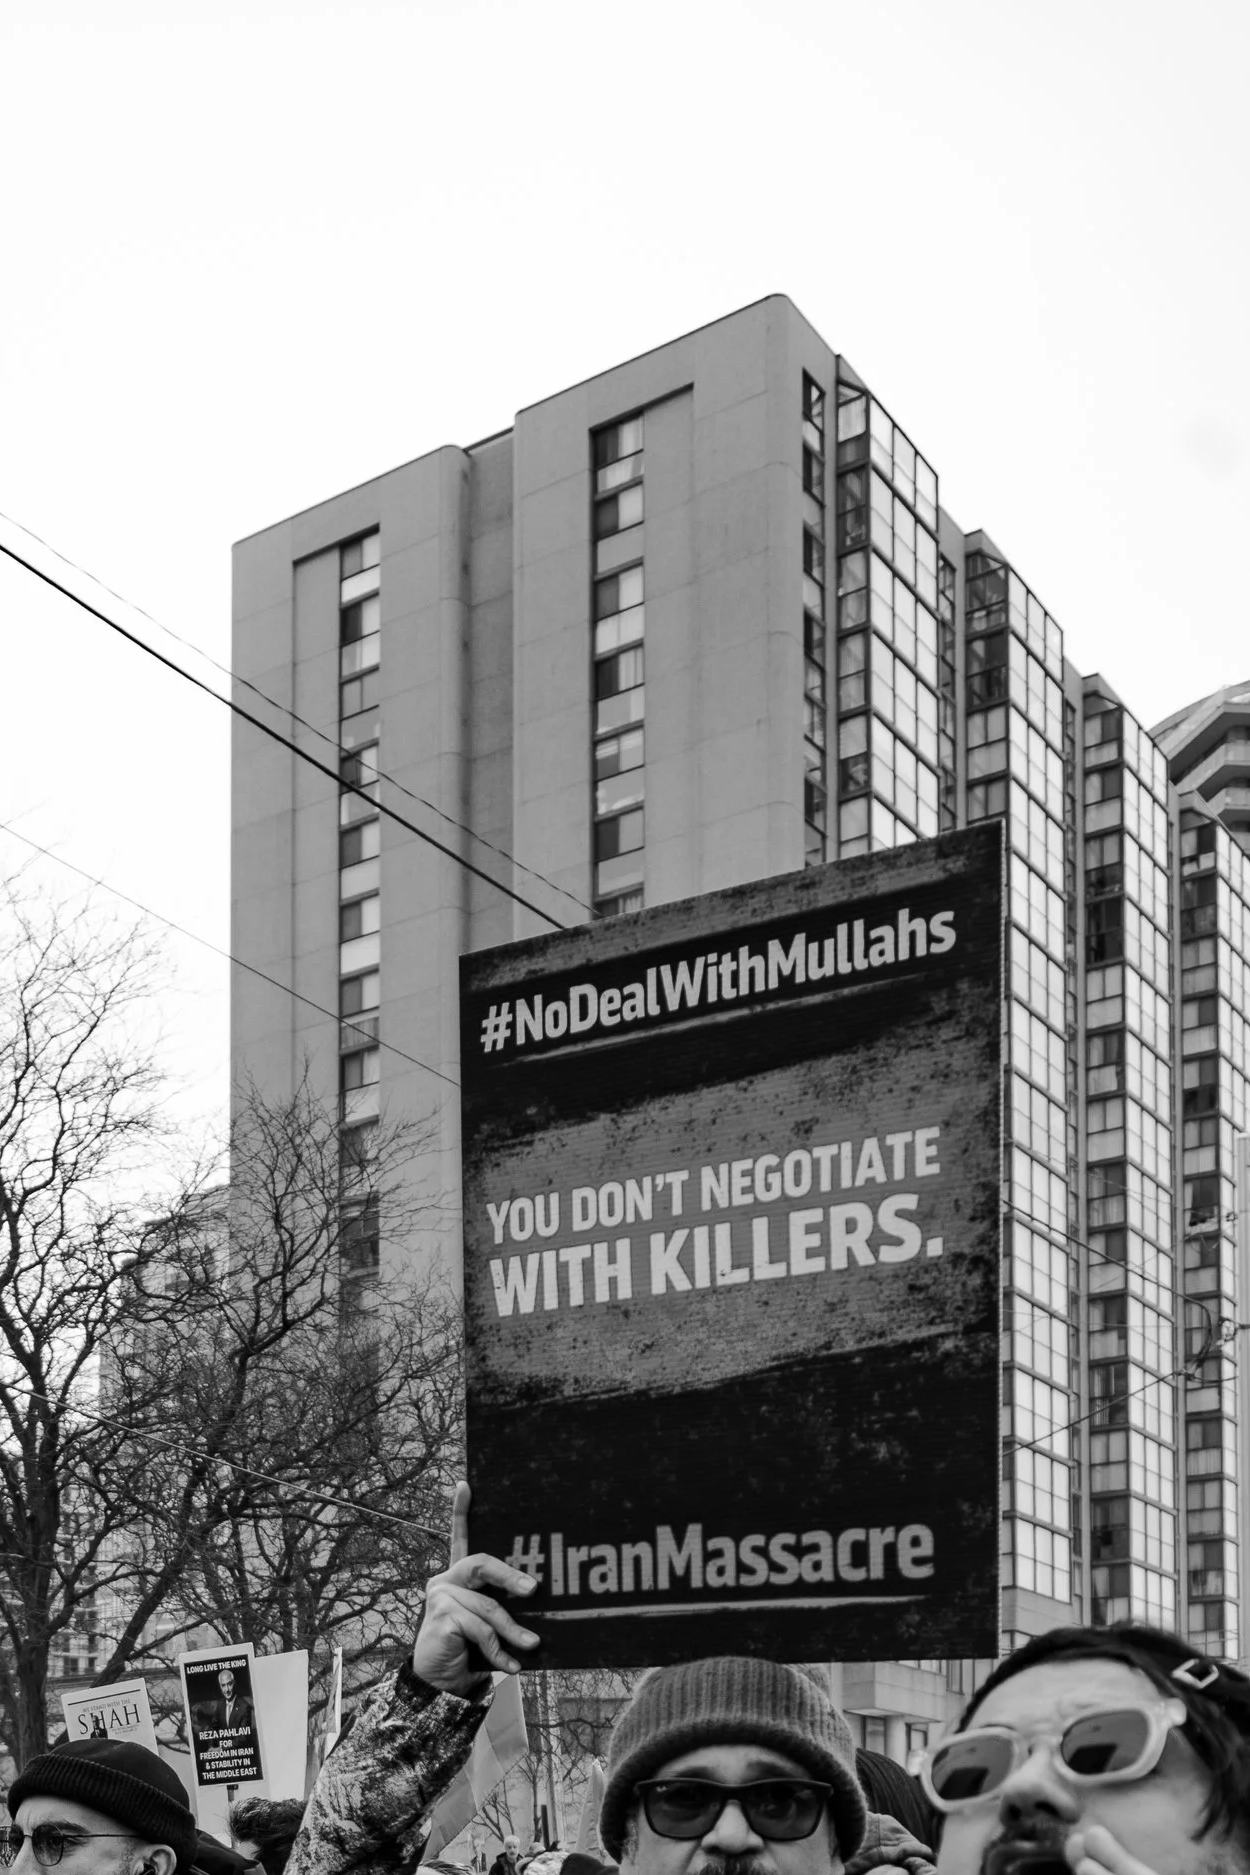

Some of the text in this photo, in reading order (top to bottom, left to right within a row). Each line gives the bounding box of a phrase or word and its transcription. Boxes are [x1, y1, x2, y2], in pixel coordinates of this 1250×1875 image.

[480, 908, 957, 1053] #NoDealWithMullahs
[486, 1126, 941, 1245] YOU DON'T NEGOTIATE
[489, 1193, 944, 1317] WITH KILLERS.
[504, 1523, 935, 1596] #IranMassacre
[186, 1658, 247, 1674] LONG LIVE THE KING
[78, 1703, 141, 1734] SHAH
[199, 1726, 251, 1740] REZA PAHLAVI
[219, 1739, 233, 1748] FOR
[200, 1747, 254, 1760] FREEDOM IN IRAN
[205, 1758, 251, 1770] & STABILITY IN
[202, 1767, 257, 1780] THE MIDDLE EAST
